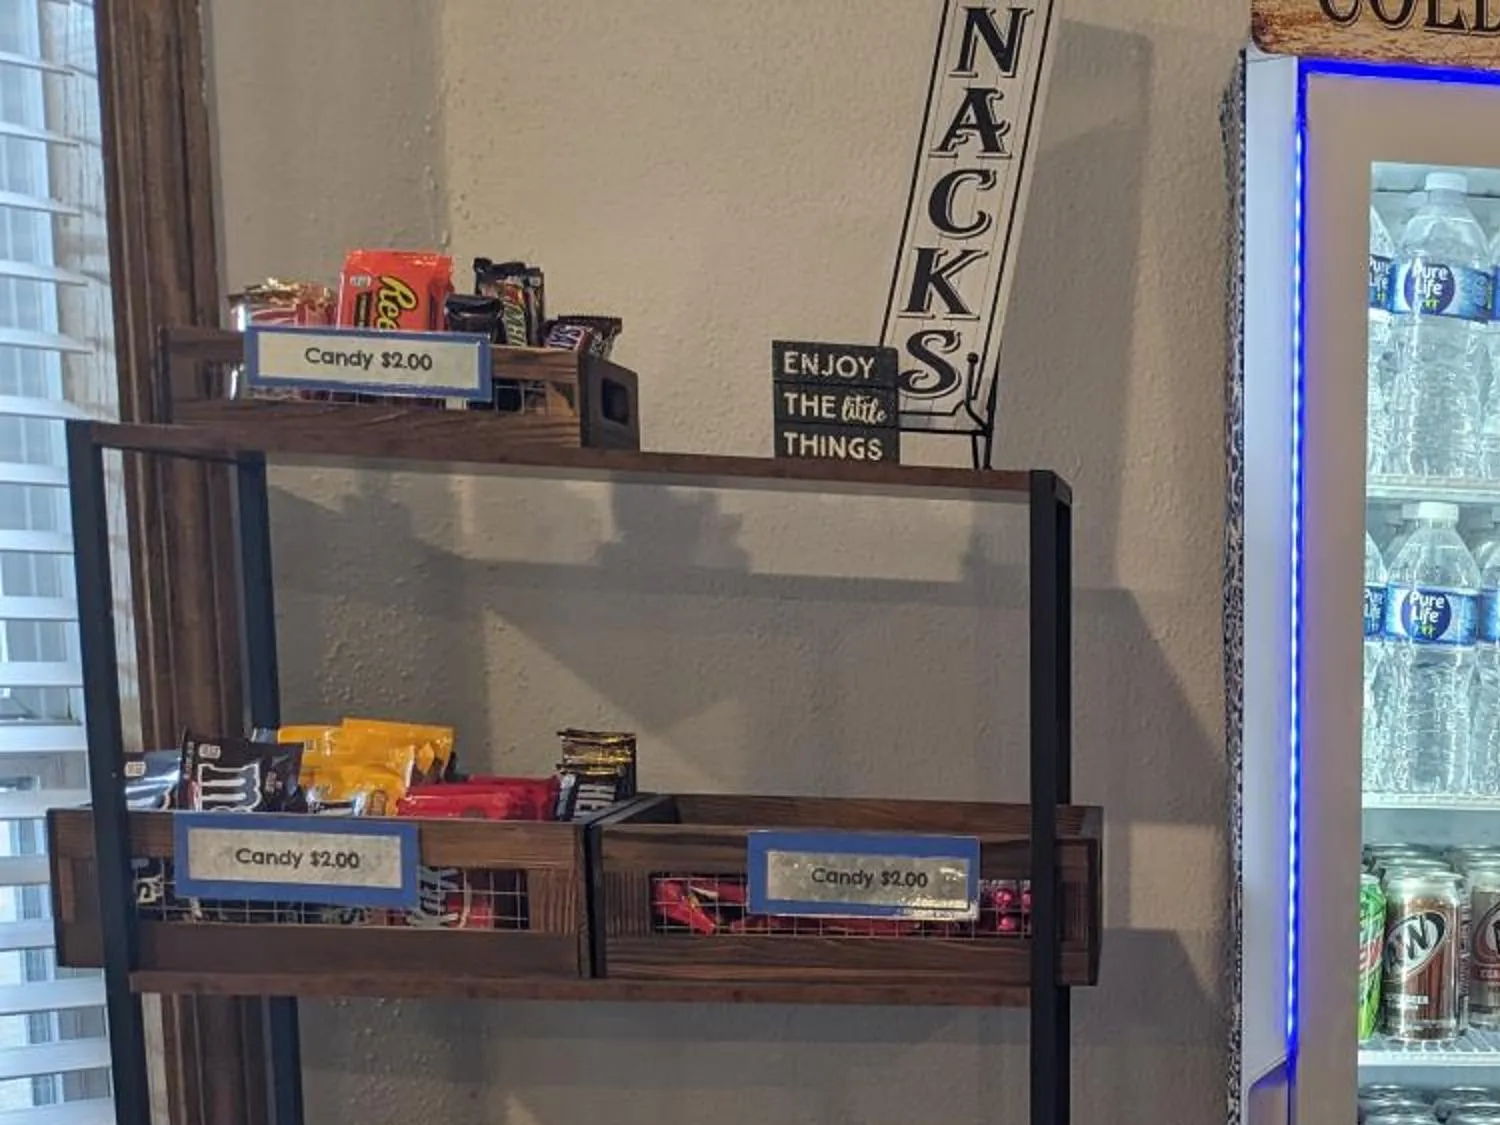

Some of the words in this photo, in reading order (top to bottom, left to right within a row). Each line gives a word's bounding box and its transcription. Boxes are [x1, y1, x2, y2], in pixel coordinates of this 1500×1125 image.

[1413, 259, 1449, 283] Pure
[1417, 281, 1442, 297] Life
[305, 347, 373, 370] Candy
[381, 352, 432, 371] $2.00
[783, 351, 875, 379] ENJOY
[784, 392, 837, 419] THE
[841, 394, 888, 425] little
[784, 432, 884, 461] THINGS
[1410, 590, 1444, 609] Pure
[1412, 607, 1439, 624] Life
[236, 847, 302, 868] Candy
[310, 850, 360, 870] $2.00
[811, 867, 873, 889] Candy
[881, 870, 927, 889] $2.00
